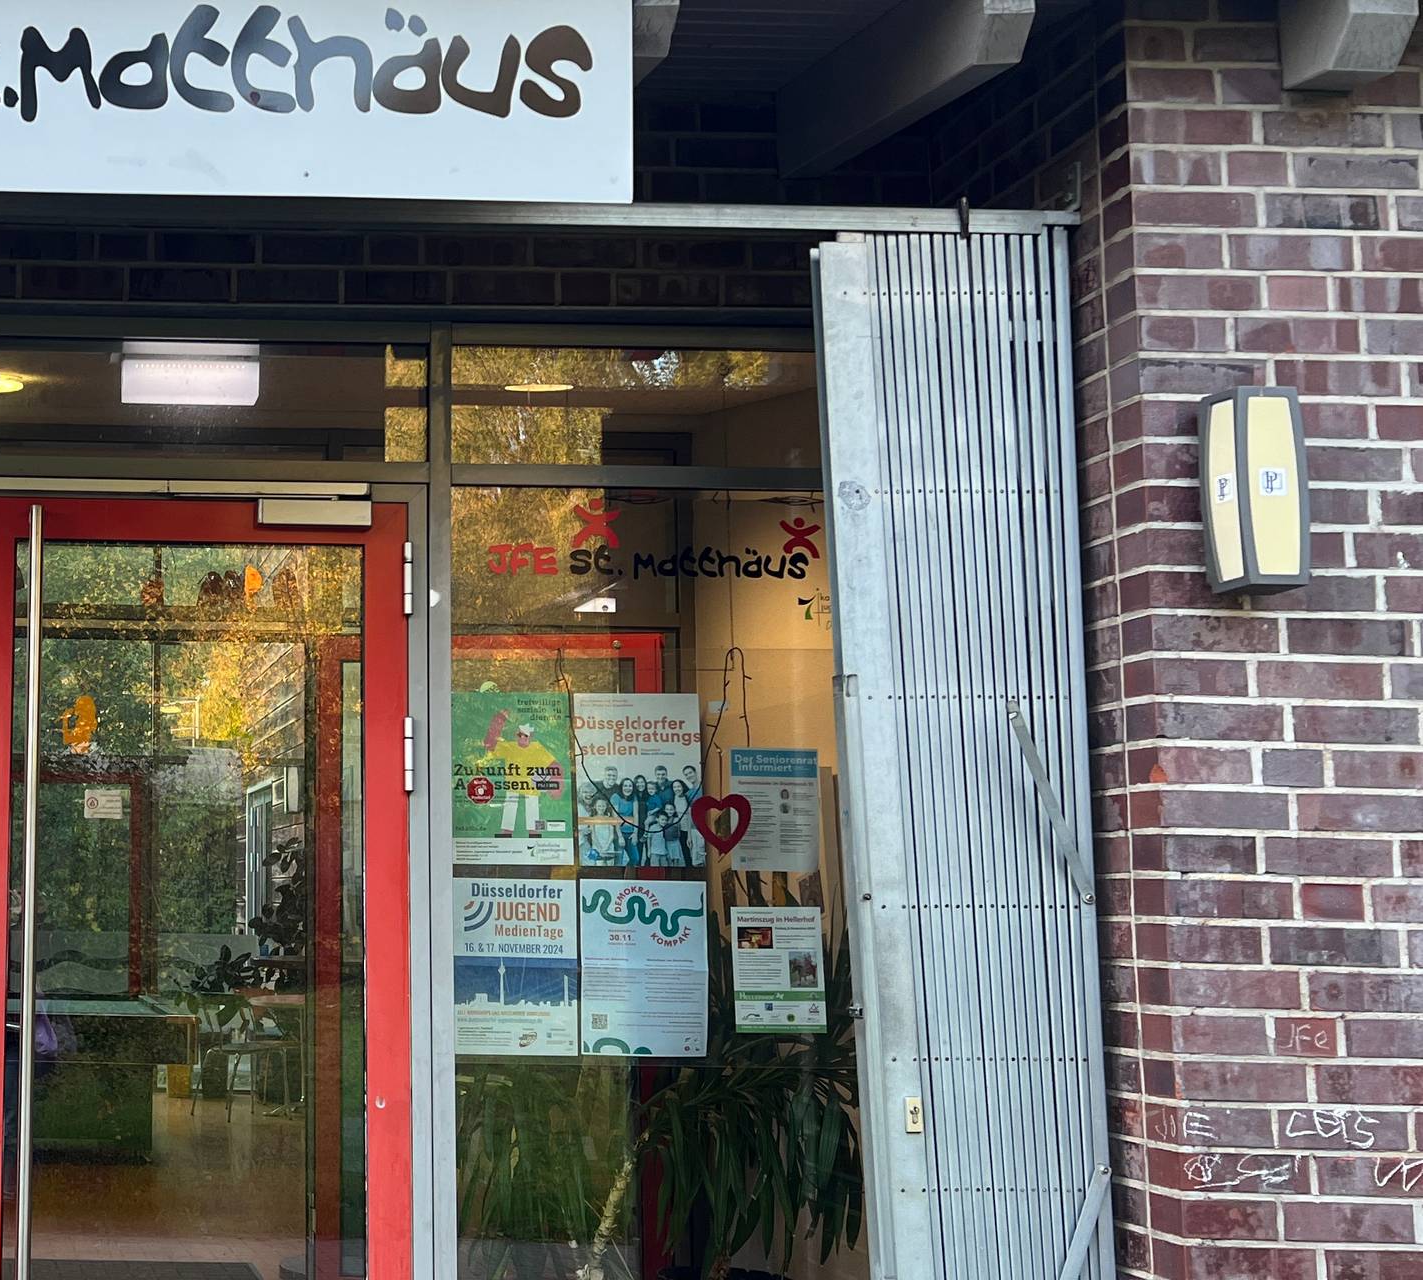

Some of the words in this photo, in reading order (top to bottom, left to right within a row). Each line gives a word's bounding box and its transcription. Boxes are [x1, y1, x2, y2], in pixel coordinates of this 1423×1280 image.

[488, 543, 559, 576] JFE
[569, 545, 624, 577] St.
[633, 546, 810, 580] Matthäus
[573, 715, 686, 730] Düsseldorfer
[613, 729, 701, 747] Beratungs
[583, 742, 638, 756] stellen
[734, 754, 753, 765] Der
[756, 755, 817, 766] Seniorenrat
[453, 763, 521, 776] Zukunft
[526, 766, 561, 776] zum
[738, 763, 793, 773] informiert
[471, 883, 563, 899] Düsseldorfer
[614, 886, 660, 913] DEMOKRATIE
[494, 901, 561, 922] JUGEND
[737, 916, 775, 924] Martinszug
[784, 916, 815, 924] Hellerhof
[494, 925, 564, 939] MedienTage
[650, 926, 693, 947] KOMPAKT
[464, 942, 476, 953] 16.
[478, 942, 484, 952] &
[486, 943, 496, 953] 17.
[498, 943, 541, 954] NOVEMBER
[543, 944, 563, 955] 2024
